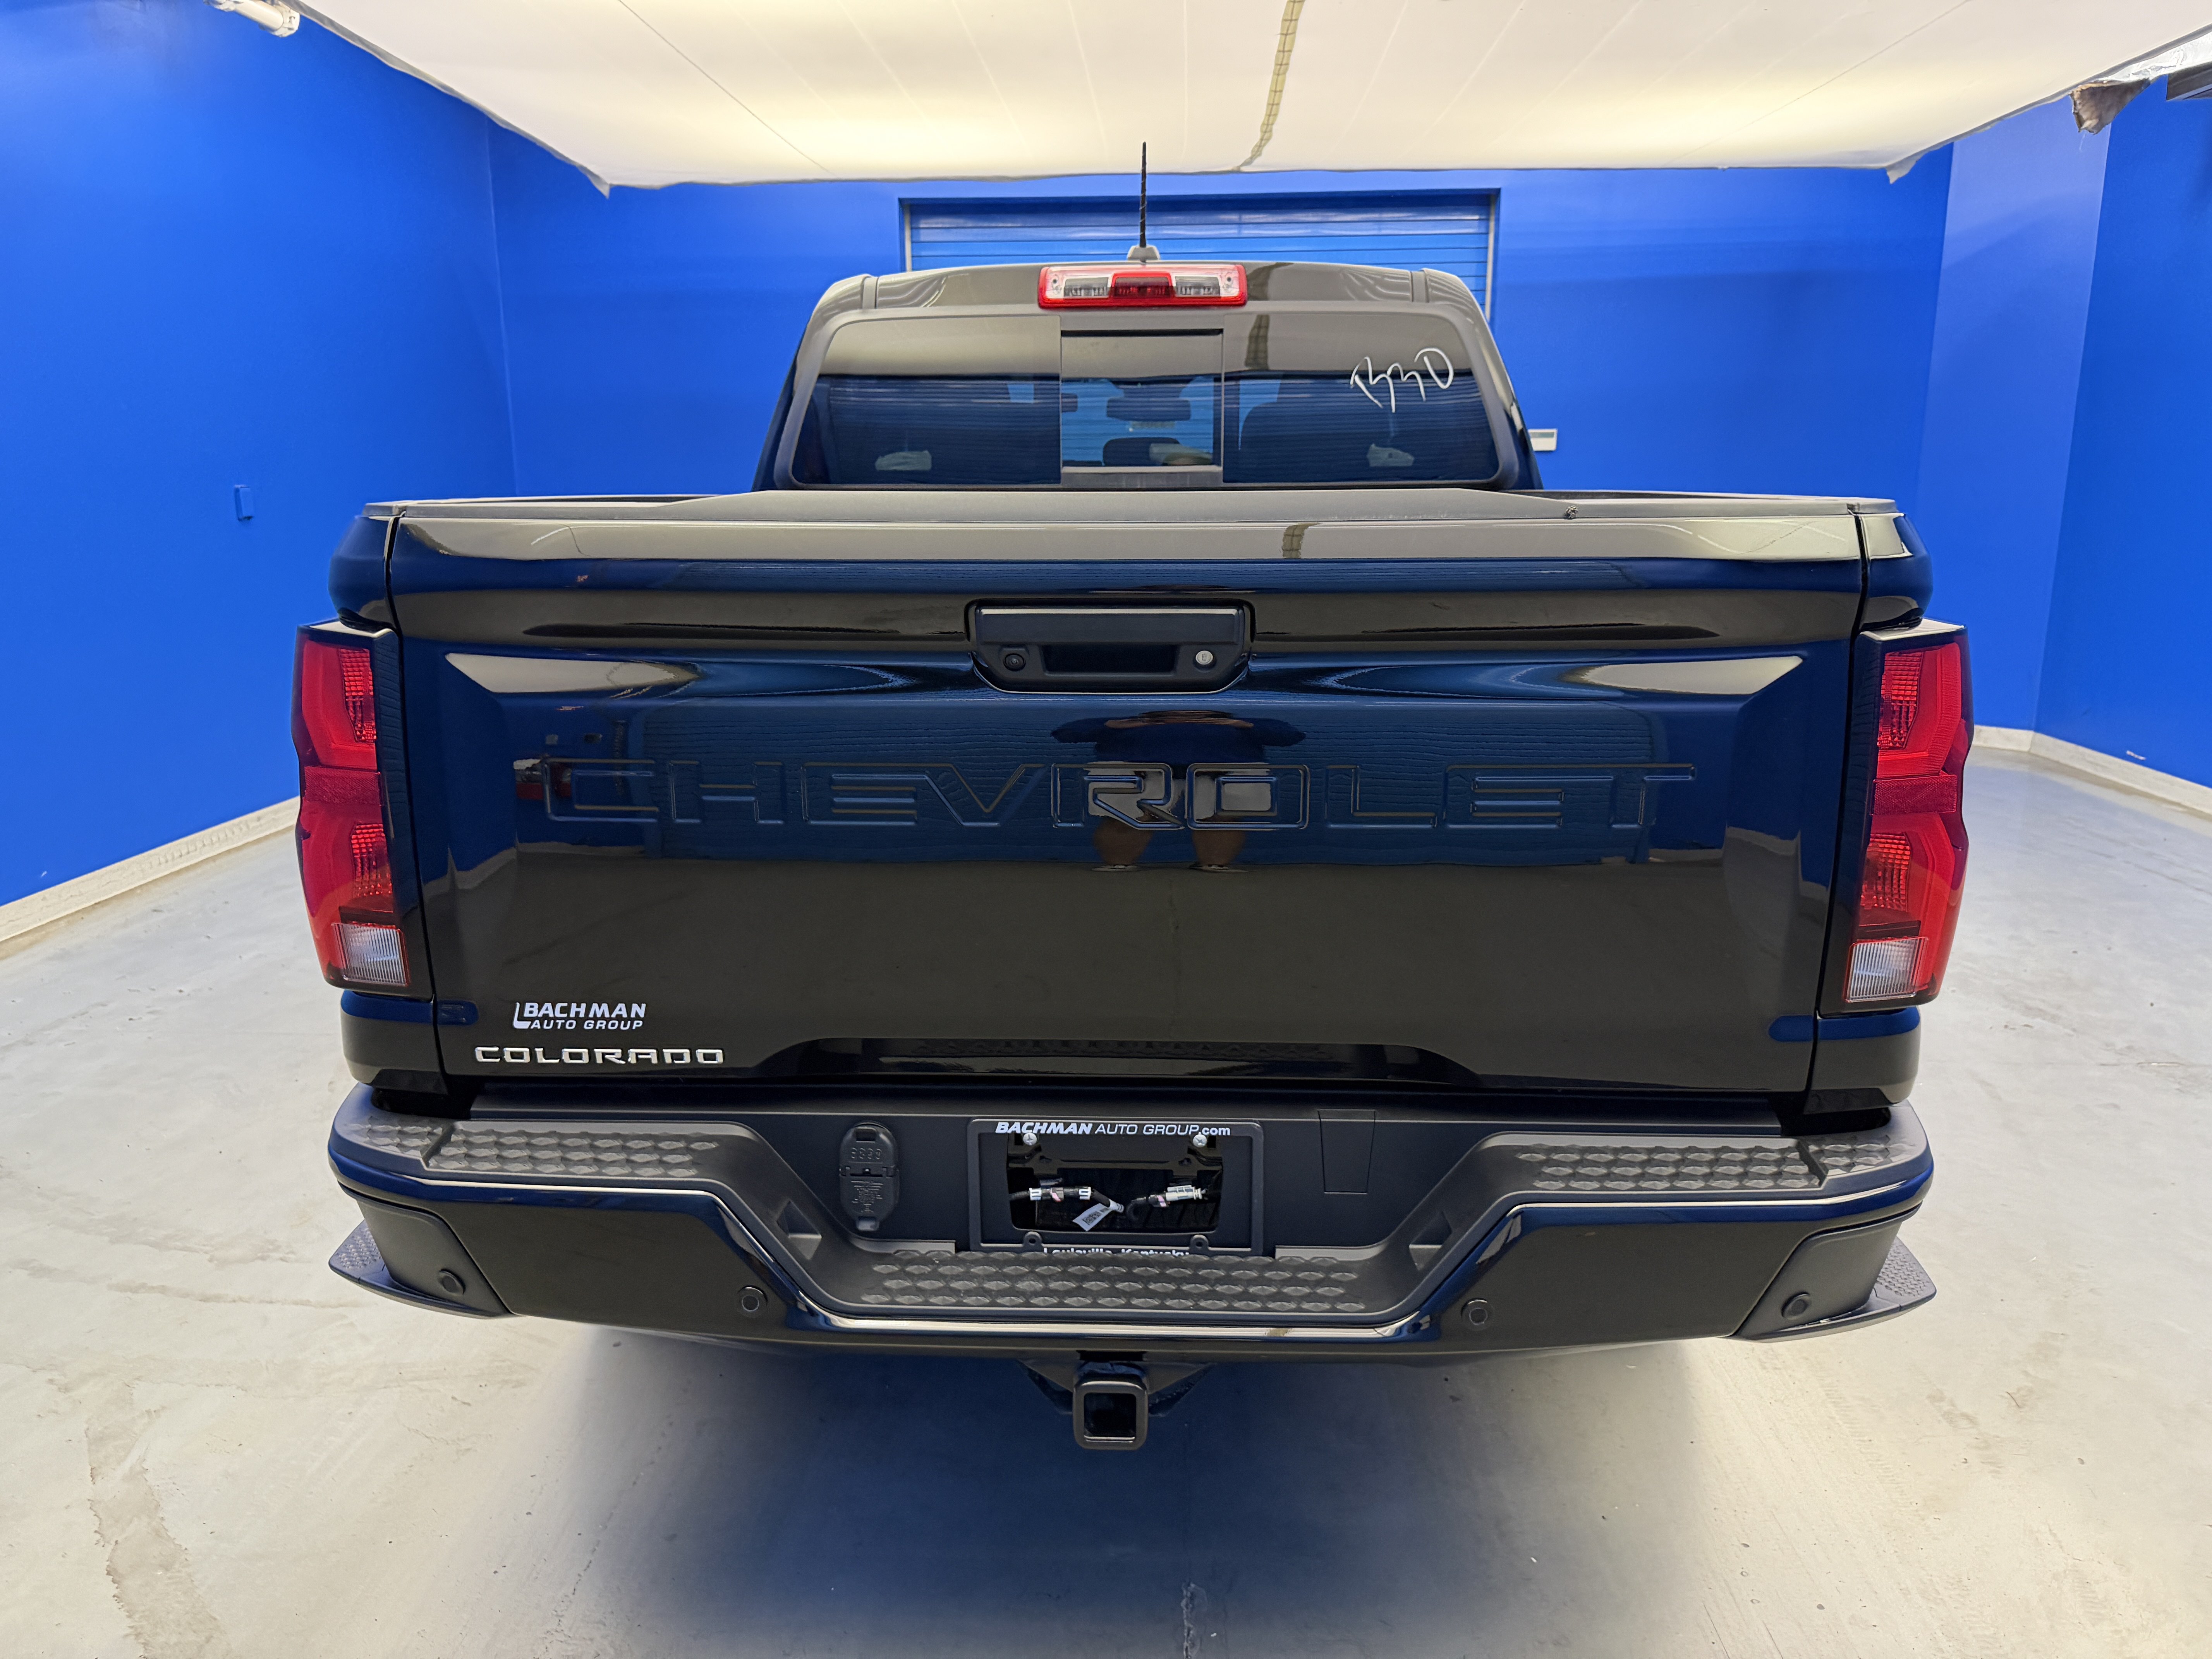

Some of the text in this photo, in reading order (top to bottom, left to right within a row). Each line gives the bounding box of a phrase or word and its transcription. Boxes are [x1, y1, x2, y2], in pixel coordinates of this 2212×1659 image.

[544, 758, 1696, 830] CHEVROLET
[523, 1002, 646, 1018] BACHMAN
[531, 1019, 644, 1030] AUTO GROUP
[474, 1046, 726, 1064] COLORADO
[994, 1121, 1093, 1135] BACHMAN
[1094, 1123, 1138, 1135] AUTO
